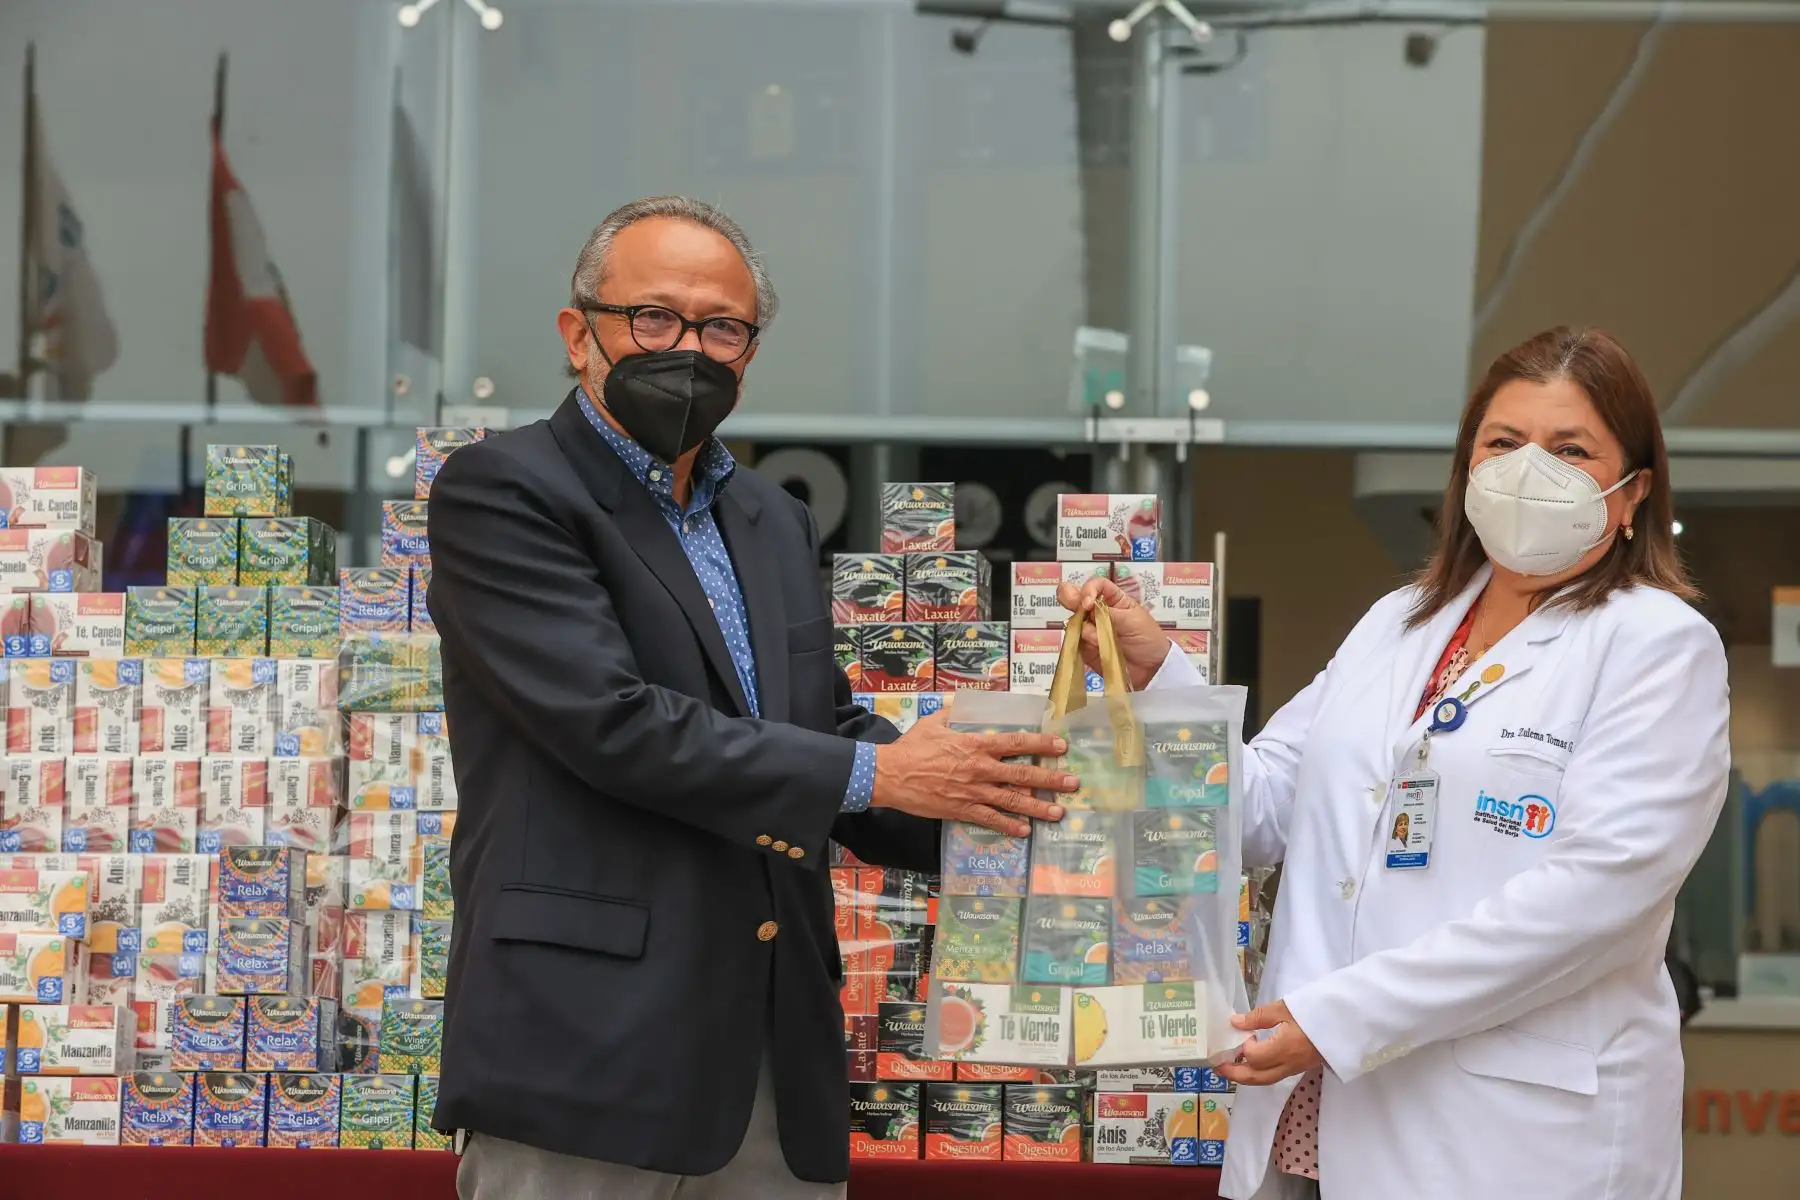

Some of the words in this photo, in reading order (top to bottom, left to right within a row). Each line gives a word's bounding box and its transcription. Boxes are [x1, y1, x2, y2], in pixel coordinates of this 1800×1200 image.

[226, 480, 256, 491] Gripal
[891, 499, 945, 510] Wawasana
[1076, 526, 1107, 539] Canela
[902, 540, 938, 551] Laxaté
[1141, 541, 1149, 552] 5
[187, 554, 217, 565] Gripal
[258, 554, 289, 565] Gripal
[839, 571, 894, 581] Wawasana
[912, 569, 968, 579] Wawasana
[1031, 595, 1061, 607] Canela
[1179, 596, 1210, 608] Canela
[359, 606, 390, 616] Relax
[850, 610, 887, 622] Laxaté
[924, 608, 961, 620] Laxaté
[92, 626, 121, 637] Canela
[146, 624, 175, 634] Gripal
[291, 623, 321, 634] Gripal
[870, 640, 925, 651] Wawasana
[943, 639, 999, 650] Wawasana
[1030, 662, 1056, 674] Canel
[881, 679, 918, 691] Laxaté
[954, 679, 991, 691] Laxaté
[1091, 676, 1101, 688] 5
[1518, 728, 1544, 741] Zulema
[1546, 733, 1567, 749] Tomas
[1153, 741, 1217, 753] Wawasana
[1476, 790, 1524, 820] insn
[968, 857, 1005, 870] Relax
[237, 885, 268, 896] Relax
[0, 910, 39, 922] anzanilla
[957, 909, 1000, 921] Wawasana
[1133, 911, 1174, 921] Wawasana
[1135, 942, 1172, 954] Relax
[237, 958, 268, 969] Relax
[45, 982, 54, 993] 5
[1146, 1000, 1193, 1011] Wawasana
[886, 1020, 925, 1031] Wawas
[999, 1014, 1016, 1041] Té
[1019, 1015, 1060, 1042] Verde
[1138, 1015, 1155, 1039] Té
[1158, 1013, 1197, 1037] Verde
[192, 1035, 224, 1047] Relax
[266, 1035, 297, 1047] Relax
[61, 1045, 112, 1058] Manzanilla
[856, 1031, 867, 1071] Laxaté
[24, 1053, 34, 1064] 5
[890, 1062, 941, 1076] Digestivo
[1183, 1072, 1192, 1083] 5
[1210, 1073, 1219, 1084] 5
[140, 1085, 177, 1093] Wawasana
[851, 1099, 909, 1110] Wawasana
[934, 1100, 992, 1112] Wawasana
[1012, 1101, 1071, 1113] Wawasana
[142, 1111, 173, 1123] Relax
[1102, 1107, 1145, 1117] Wawasana
[1695, 1088, 1800, 1134] nve
[64, 1117, 116, 1131] Manzanilla
[213, 1113, 245, 1125] Relax
[288, 1114, 320, 1126] Relax
[361, 1113, 393, 1126] Gripal
[26, 1127, 36, 1138] 5
[1097, 1125, 1127, 1144] Anís
[857, 1141, 906, 1154] Digestivo
[940, 1142, 990, 1155] Digestivo
[1018, 1143, 1068, 1156] Digestivo
[1180, 1143, 1189, 1155] 5
[1207, 1145, 1217, 1156] 5
